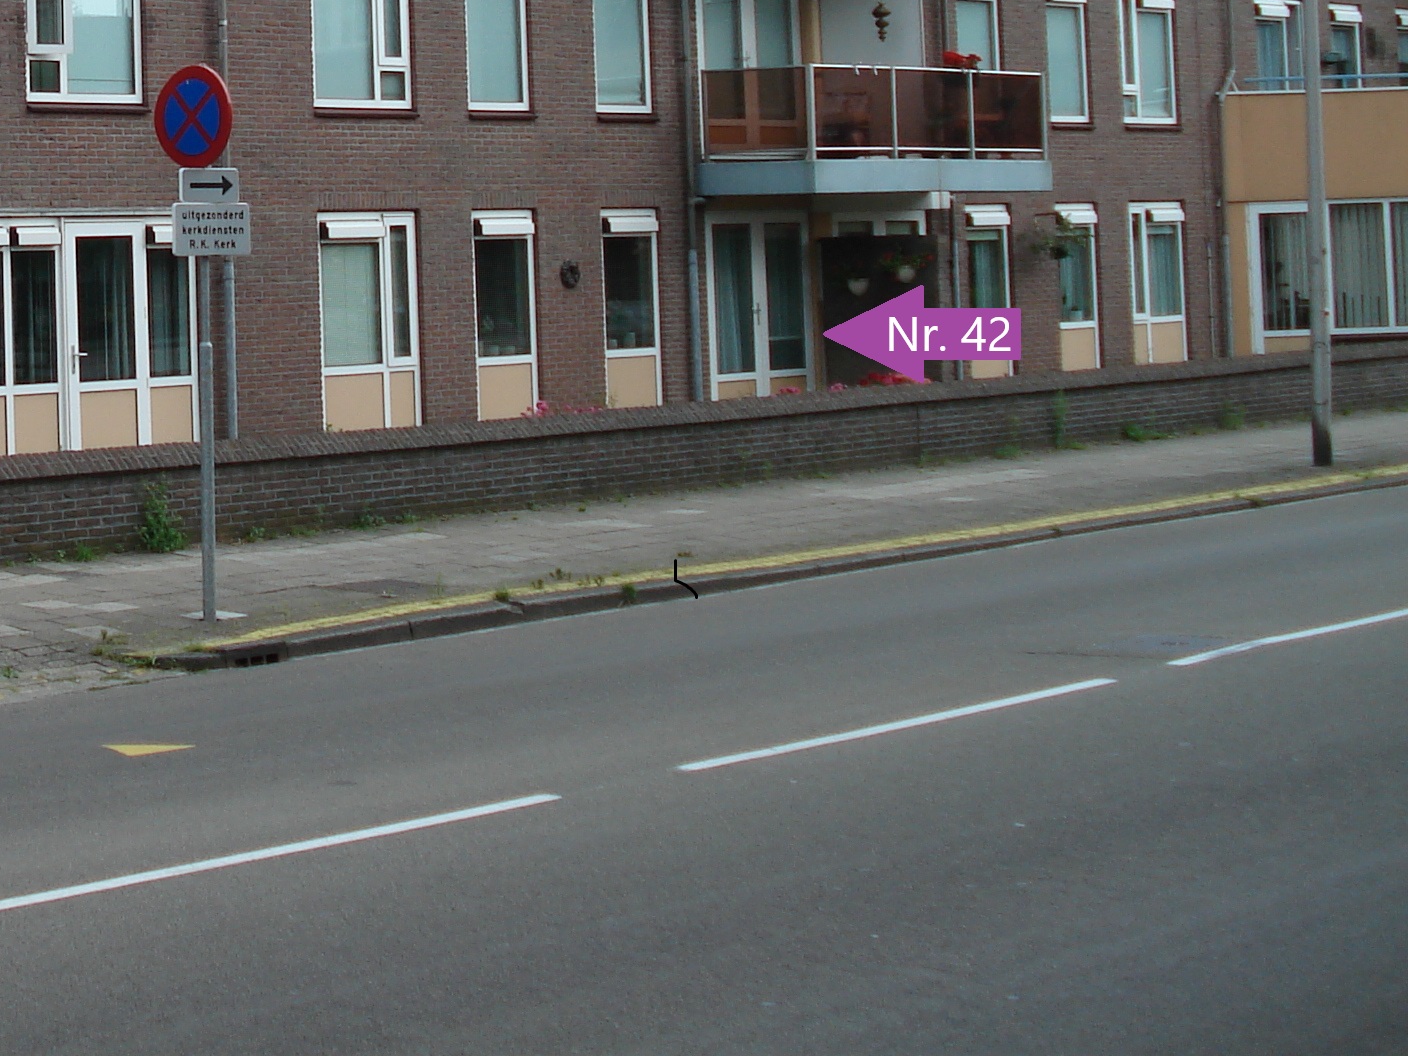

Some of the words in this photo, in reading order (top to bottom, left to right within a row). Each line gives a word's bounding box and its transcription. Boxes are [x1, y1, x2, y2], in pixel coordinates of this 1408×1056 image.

[182, 210, 244, 221] uitgezonderd
[182, 225, 244, 235] kerkdiensten
[189, 239, 209, 249] R.K.
[214, 239, 237, 249] Kerk
